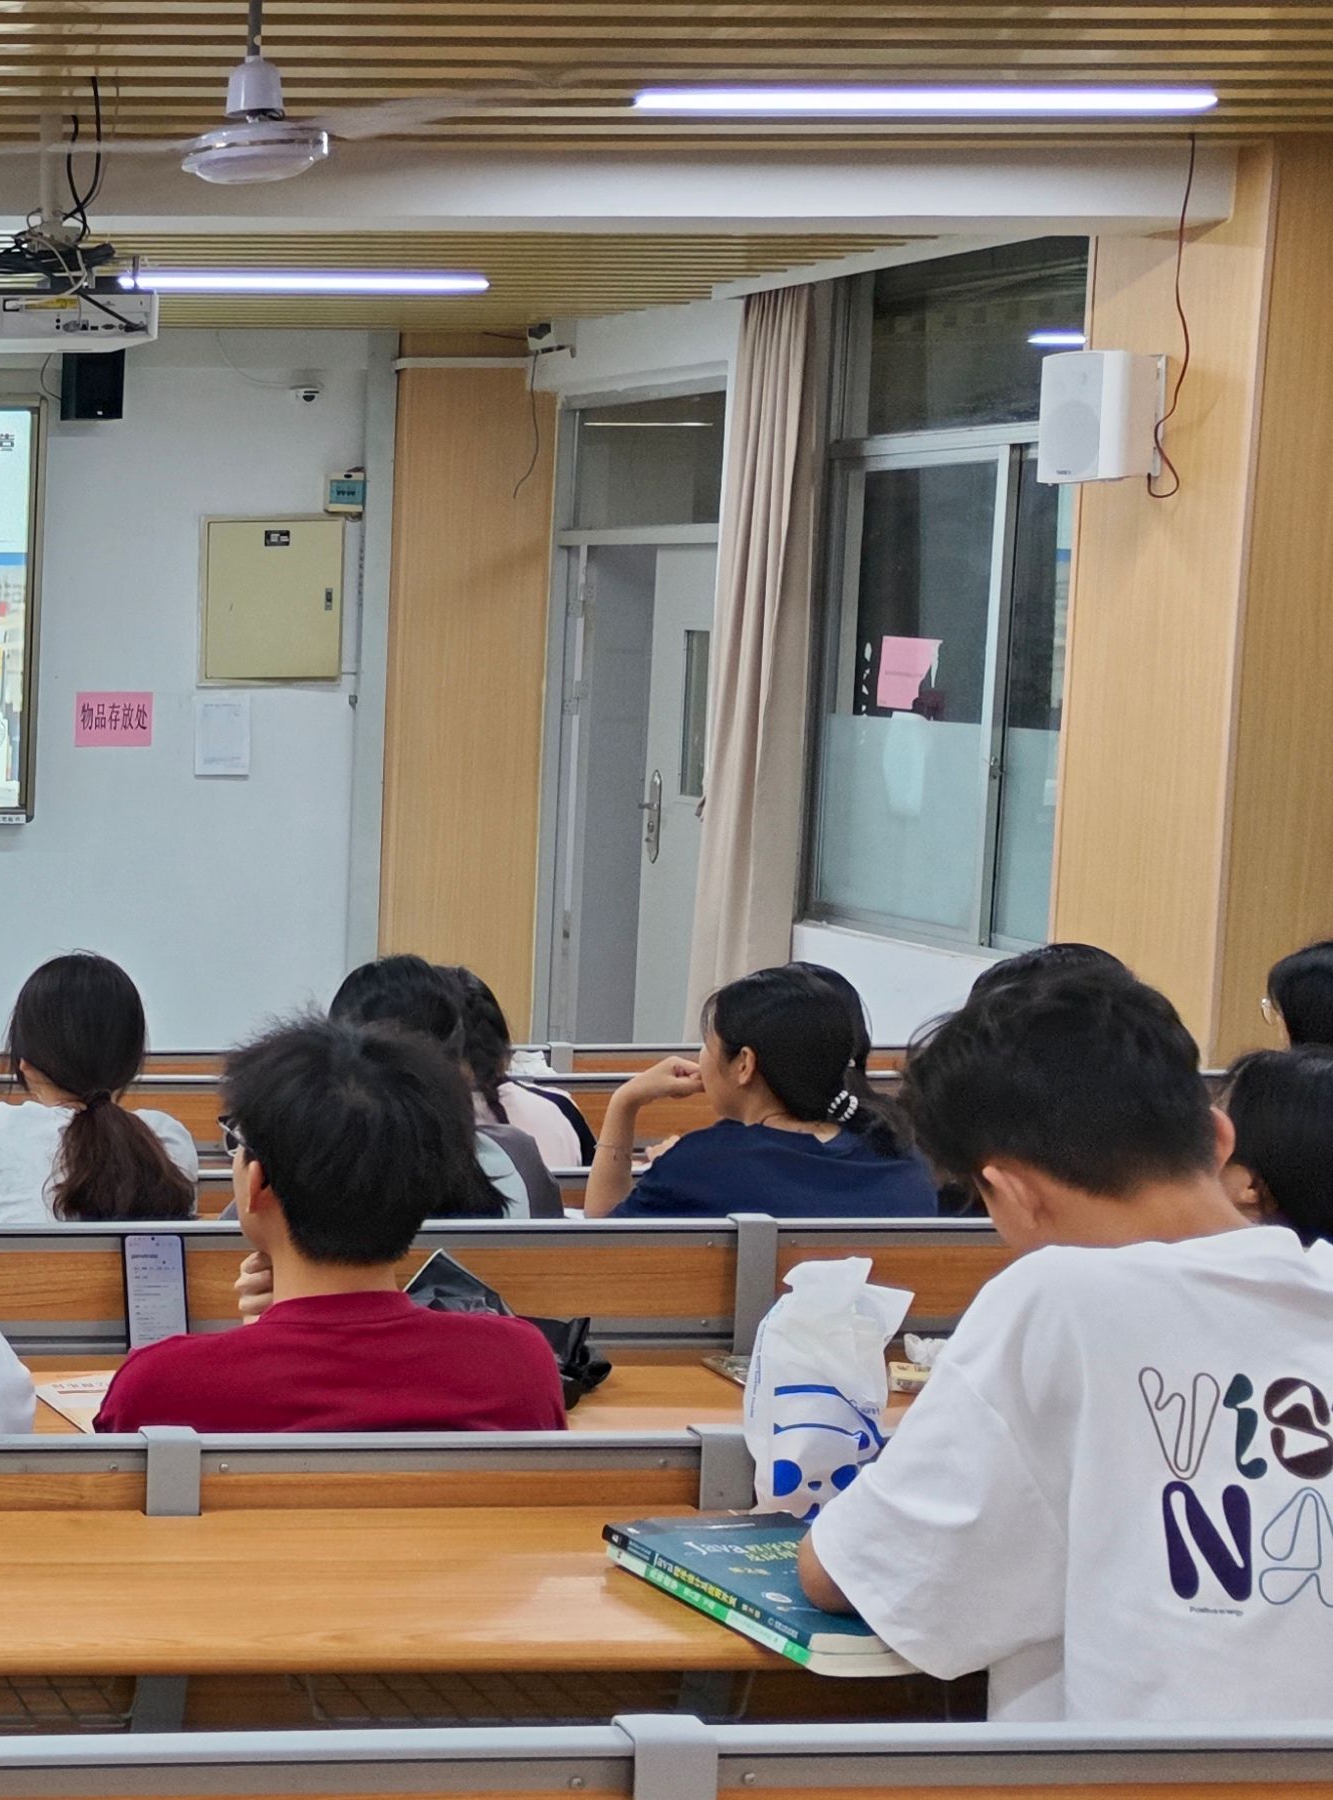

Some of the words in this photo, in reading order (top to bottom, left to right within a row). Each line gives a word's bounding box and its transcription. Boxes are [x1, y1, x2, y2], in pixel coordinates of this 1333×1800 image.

[80, 703, 148, 730] 物品存放处
